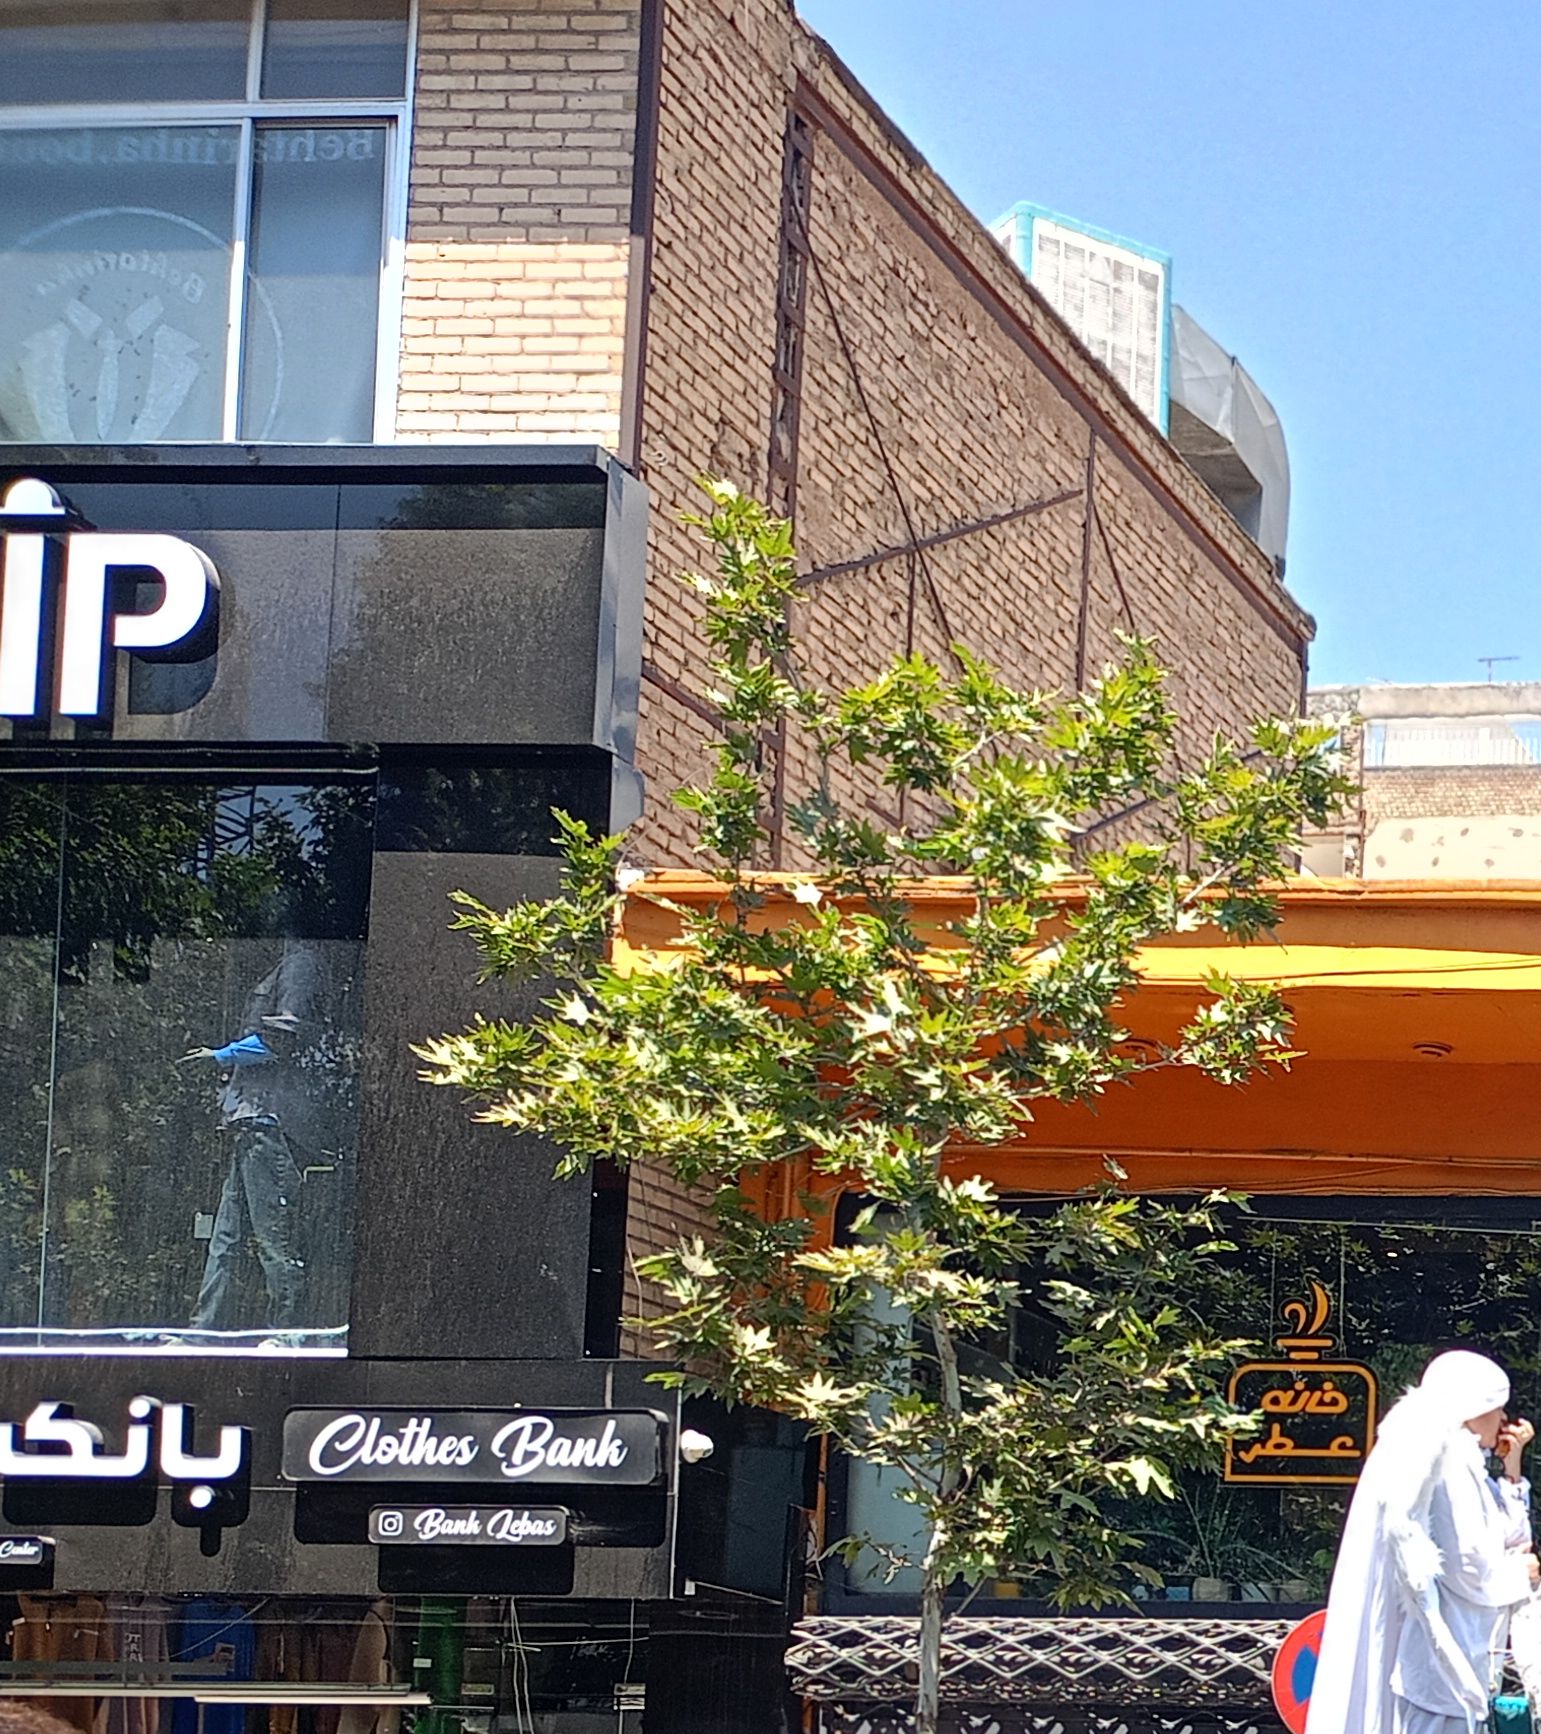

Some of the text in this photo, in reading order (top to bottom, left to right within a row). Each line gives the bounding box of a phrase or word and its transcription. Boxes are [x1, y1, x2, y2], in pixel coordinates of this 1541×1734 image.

[1260, 1381, 1348, 1414] خانه
[308, 1413, 628, 1478] Clothes Bank
[1238, 1422, 1361, 1464] عطر
[413, 1508, 558, 1542] Bank Lebas
